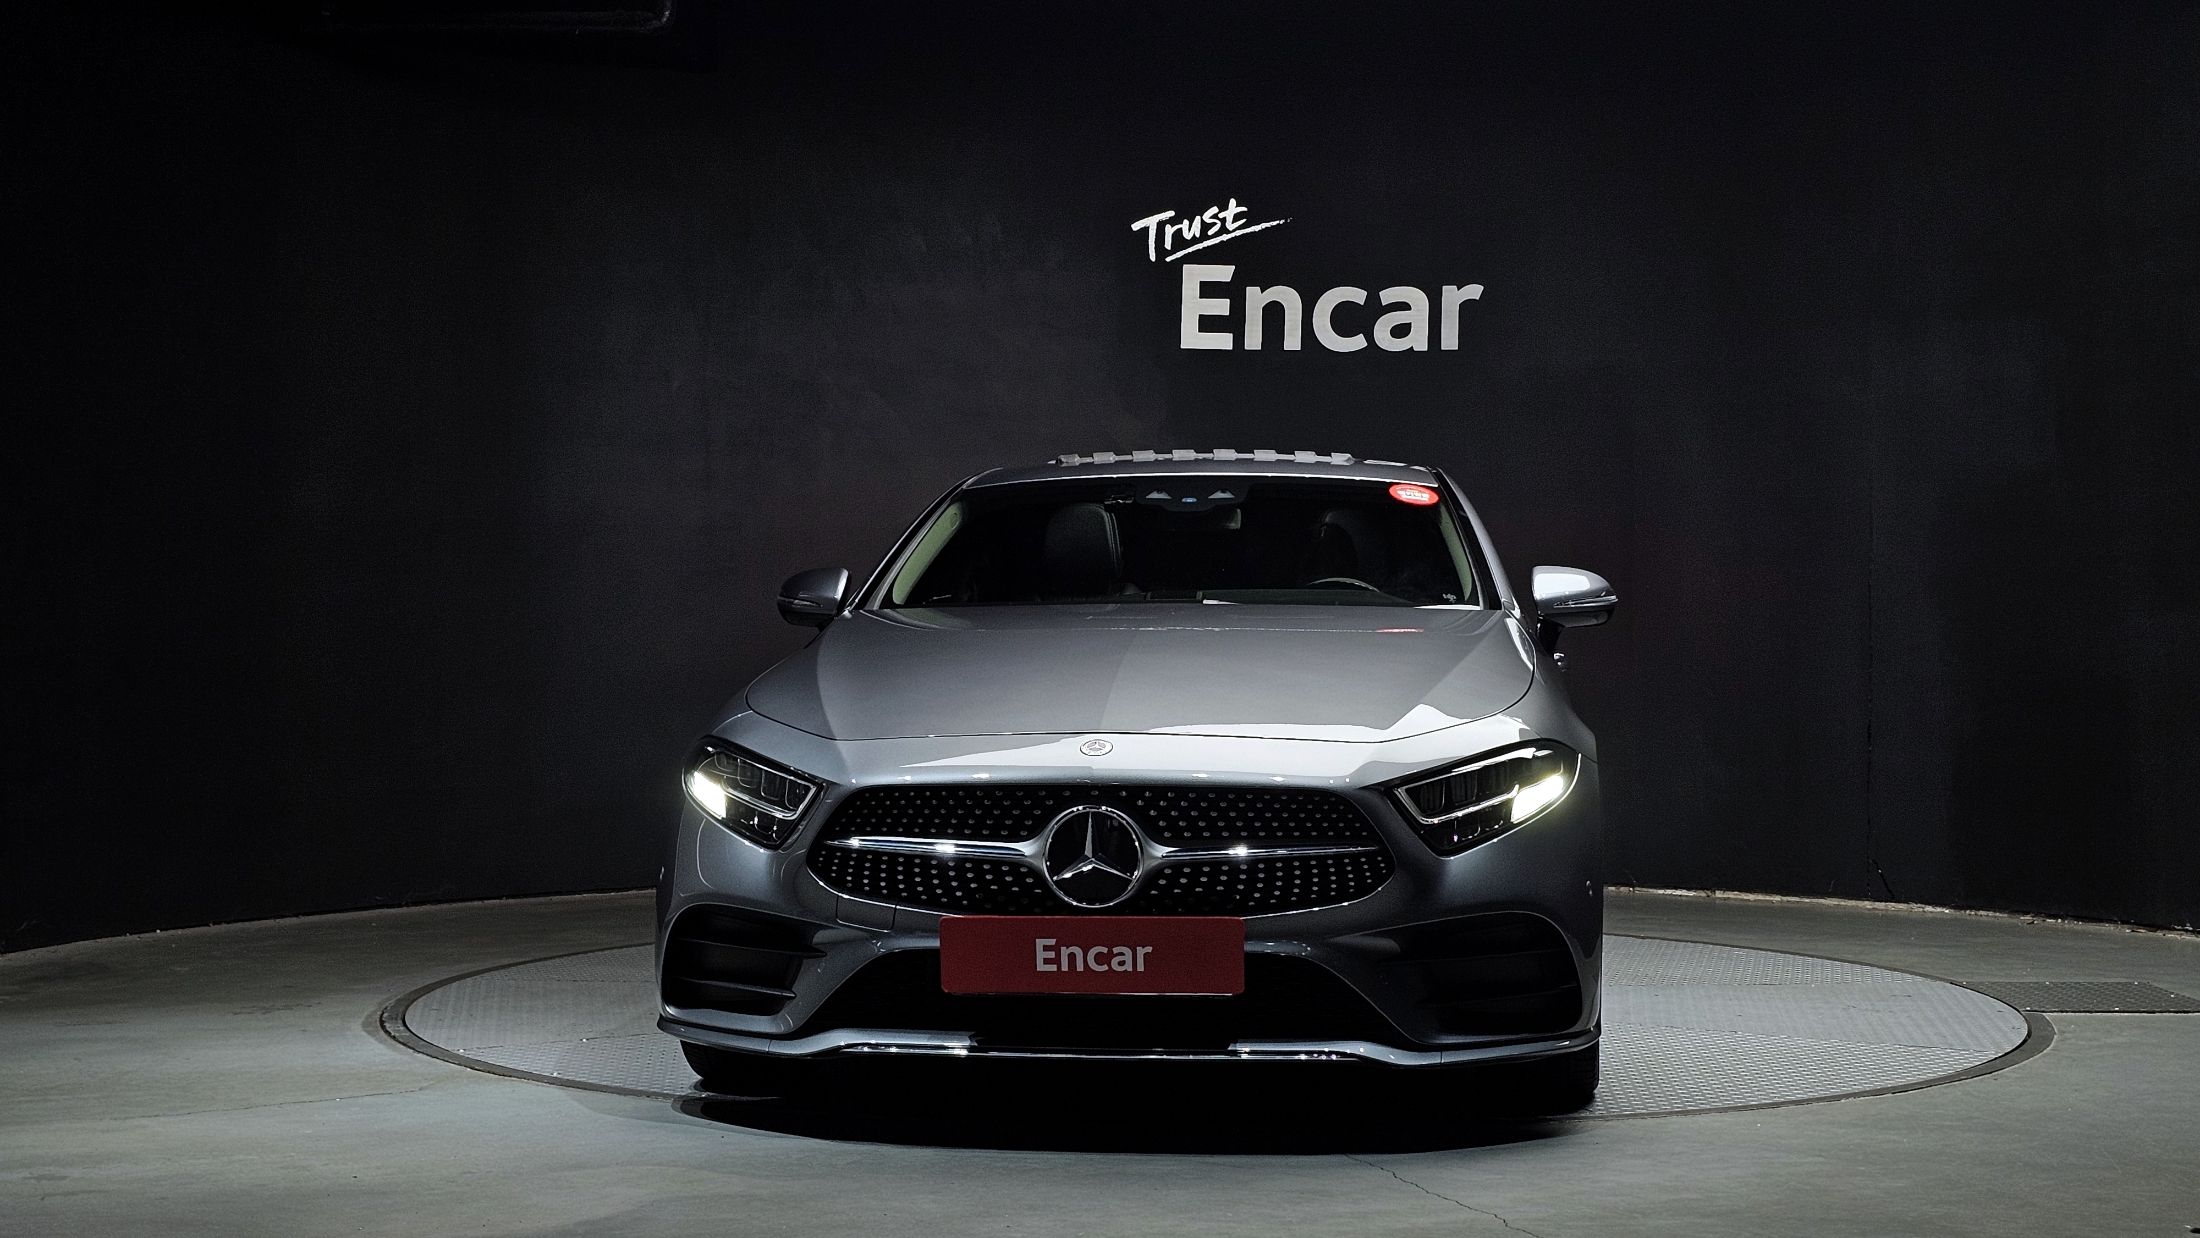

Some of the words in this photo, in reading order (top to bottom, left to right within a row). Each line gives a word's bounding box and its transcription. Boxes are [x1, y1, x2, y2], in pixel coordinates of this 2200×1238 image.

[1131, 198, 1248, 262] Trust
[1180, 264, 1484, 352] Encar
[1035, 938, 1153, 972] Encar
